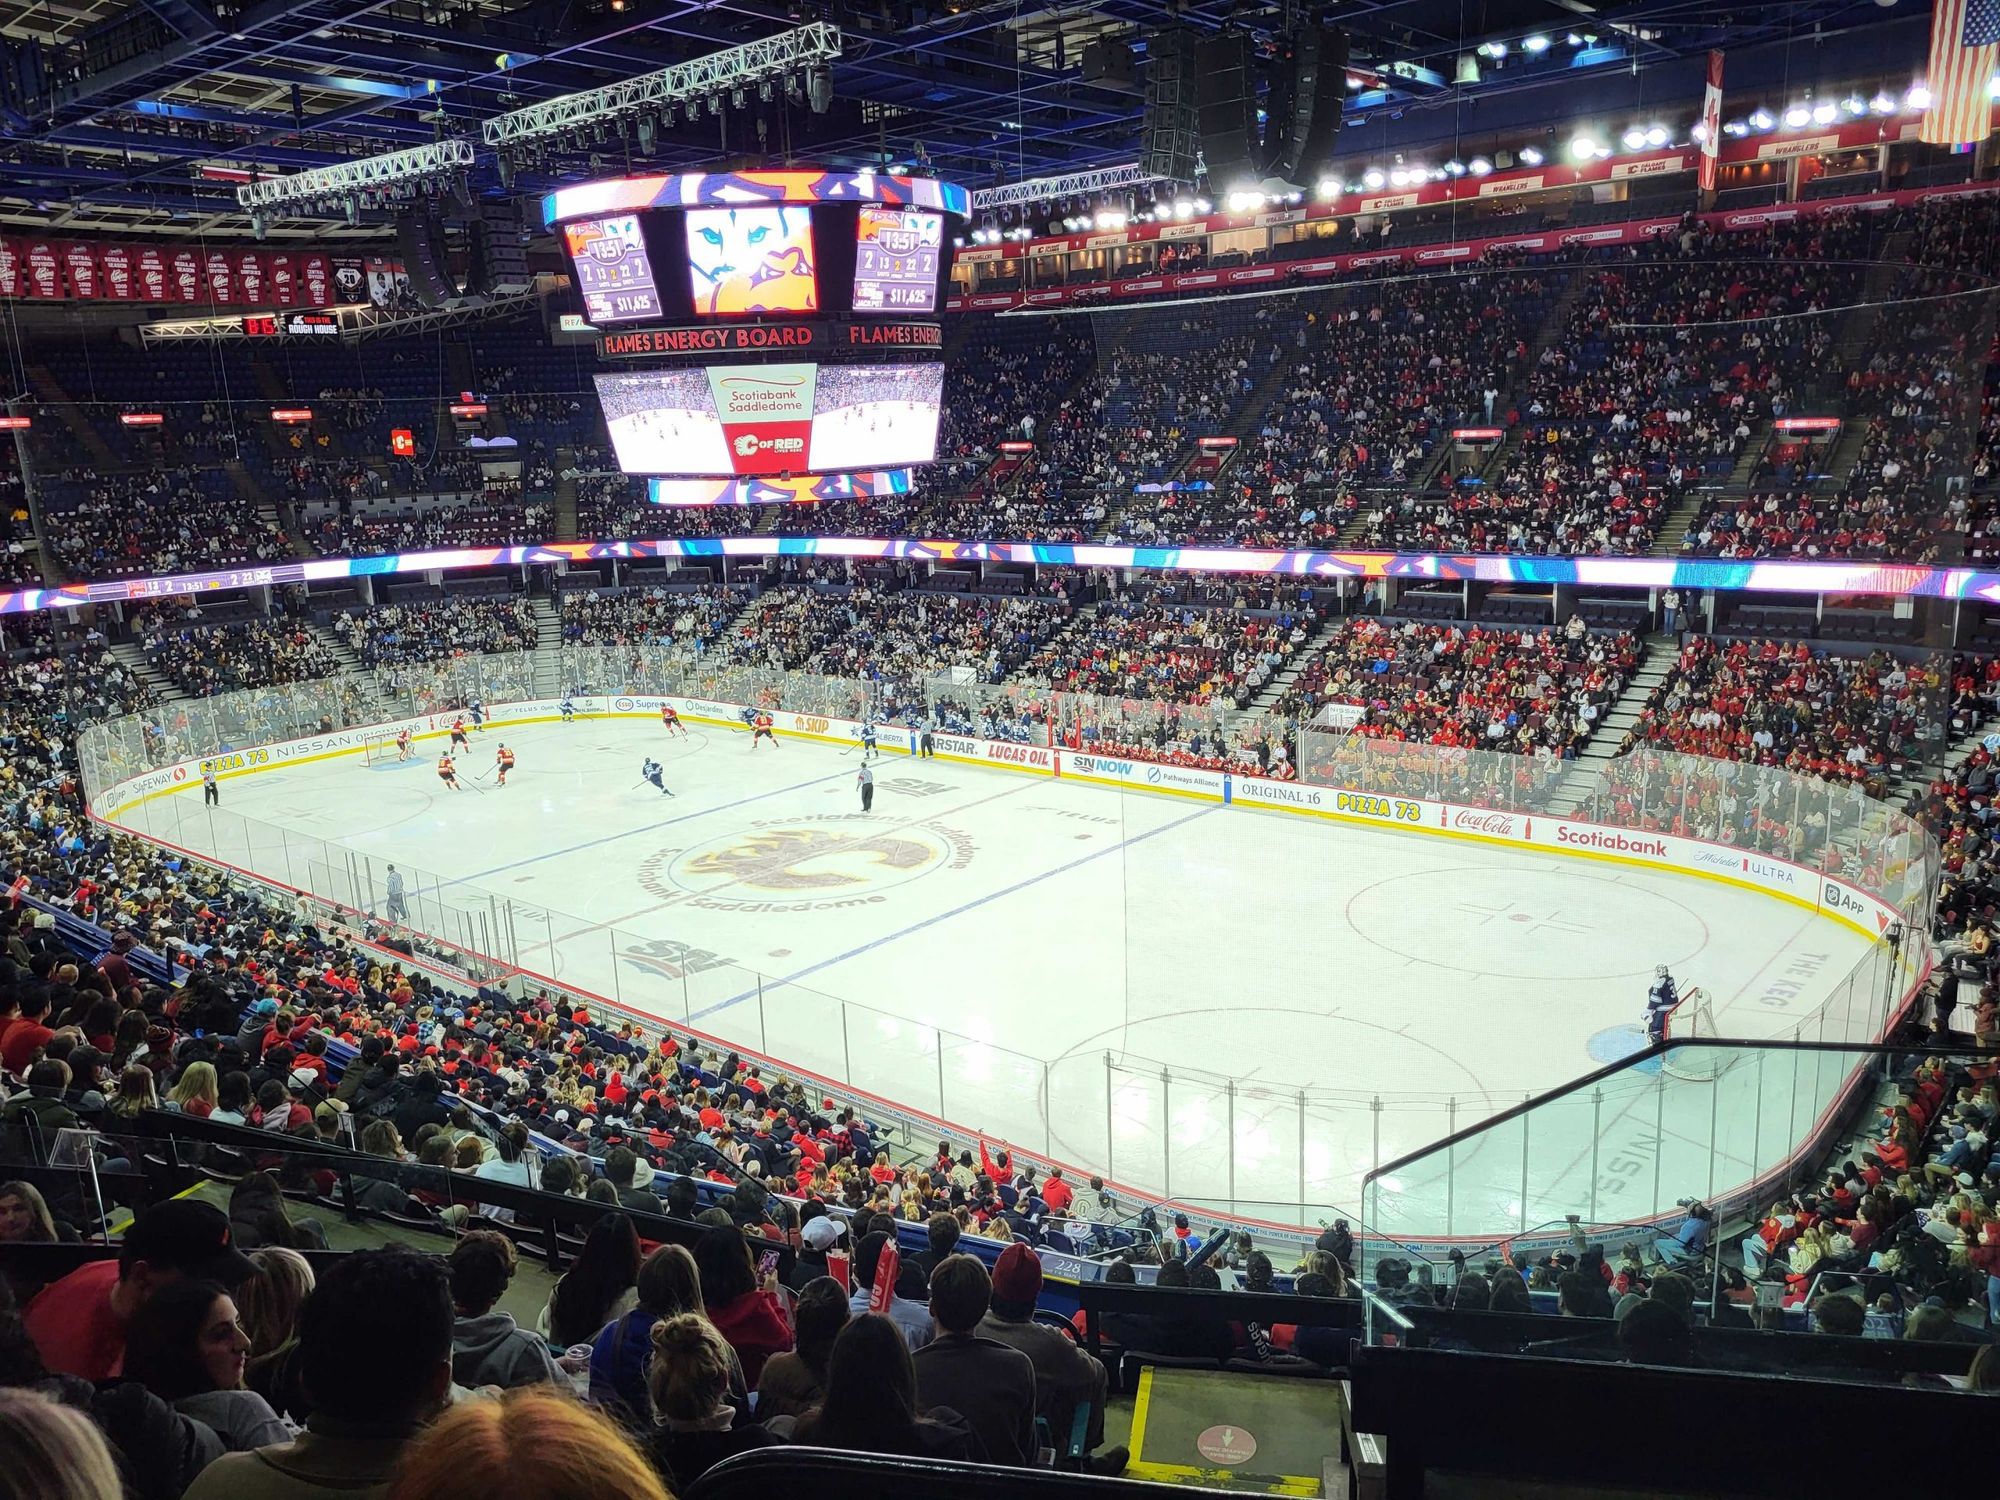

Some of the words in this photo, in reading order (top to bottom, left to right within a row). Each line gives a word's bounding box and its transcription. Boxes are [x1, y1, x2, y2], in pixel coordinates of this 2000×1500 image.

[1775, 142, 1819, 155] WRANGLERS
[1640, 164, 1666, 172] FLAMES
[1492, 182, 1528, 193] WRANGLERS
[593, 239, 622, 260] 13:51
[885, 232, 915, 250] 13:51
[583, 264, 593, 282] 2
[596, 268, 606, 280] 13
[610, 269, 617, 280] 2
[620, 264, 630, 278] 22
[634, 258, 645, 277] 2
[864, 250, 874, 269] 2
[880, 257, 890, 269] 13
[894, 260, 900, 271] 2
[906, 258, 916, 270] 22
[923, 254, 932, 272] 2
[344, 274, 356, 284] 20
[617, 294, 650, 312] $11,625
[890, 288, 926, 306] $11,625
[288, 325, 313, 334] ROUGH
[314, 324, 338, 334] HOUSE
[850, 326, 910, 344] FLAMES
[606, 334, 650, 354] FLAMES
[654, 330, 729, 350] ENERGY
[736, 326, 812, 347] BOARD
[732, 388, 797, 401] Scotiabank
[728, 402, 802, 413] Saddledome
[758, 440, 774, 449] OF
[774, 438, 804, 449] RED
[164, 580, 174, 592] 2
[182, 581, 204, 591] 13:51
[230, 574, 238, 586] 2
[242, 572, 252, 582] 22
[694, 700, 724, 714] Desjardins
[1330, 706, 1364, 715] NISSAN
[805, 716, 829, 734] SKIP
[874, 732, 904, 743] ALBERTA
[276, 736, 350, 758] NISSAN
[988, 744, 1026, 764] LUCAS
[1030, 750, 1048, 766] OIL
[249, 748, 270, 765] 73
[1074, 756, 1095, 768] SN
[1096, 756, 1133, 775] NOW
[132, 772, 172, 794] SAFEWAY
[1163, 773, 1192, 786] Pathways
[1194, 776, 1220, 788] Alliance
[1242, 783, 1303, 802] ORIGINAL
[1306, 792, 1320, 804] 16
[1337, 793, 1390, 817] PIZZA
[1395, 802, 1421, 821] 73
[1056, 809, 1122, 824] TELUS
[1454, 810, 1513, 836] Coca-Cola
[920, 820, 981, 870] Saddledome
[1557, 826, 1668, 858] Scotiabank
[636, 847, 682, 900] Scotiabank
[1694, 850, 1739, 869] Michelob
[1751, 862, 1794, 885] ULTRA
[684, 896, 888, 912] Saddledome
[1841, 894, 1864, 916] App
[1792, 953, 1830, 978] THE
[1760, 979, 1805, 1008] KEG
[1056, 1259, 1081, 1274] 228
